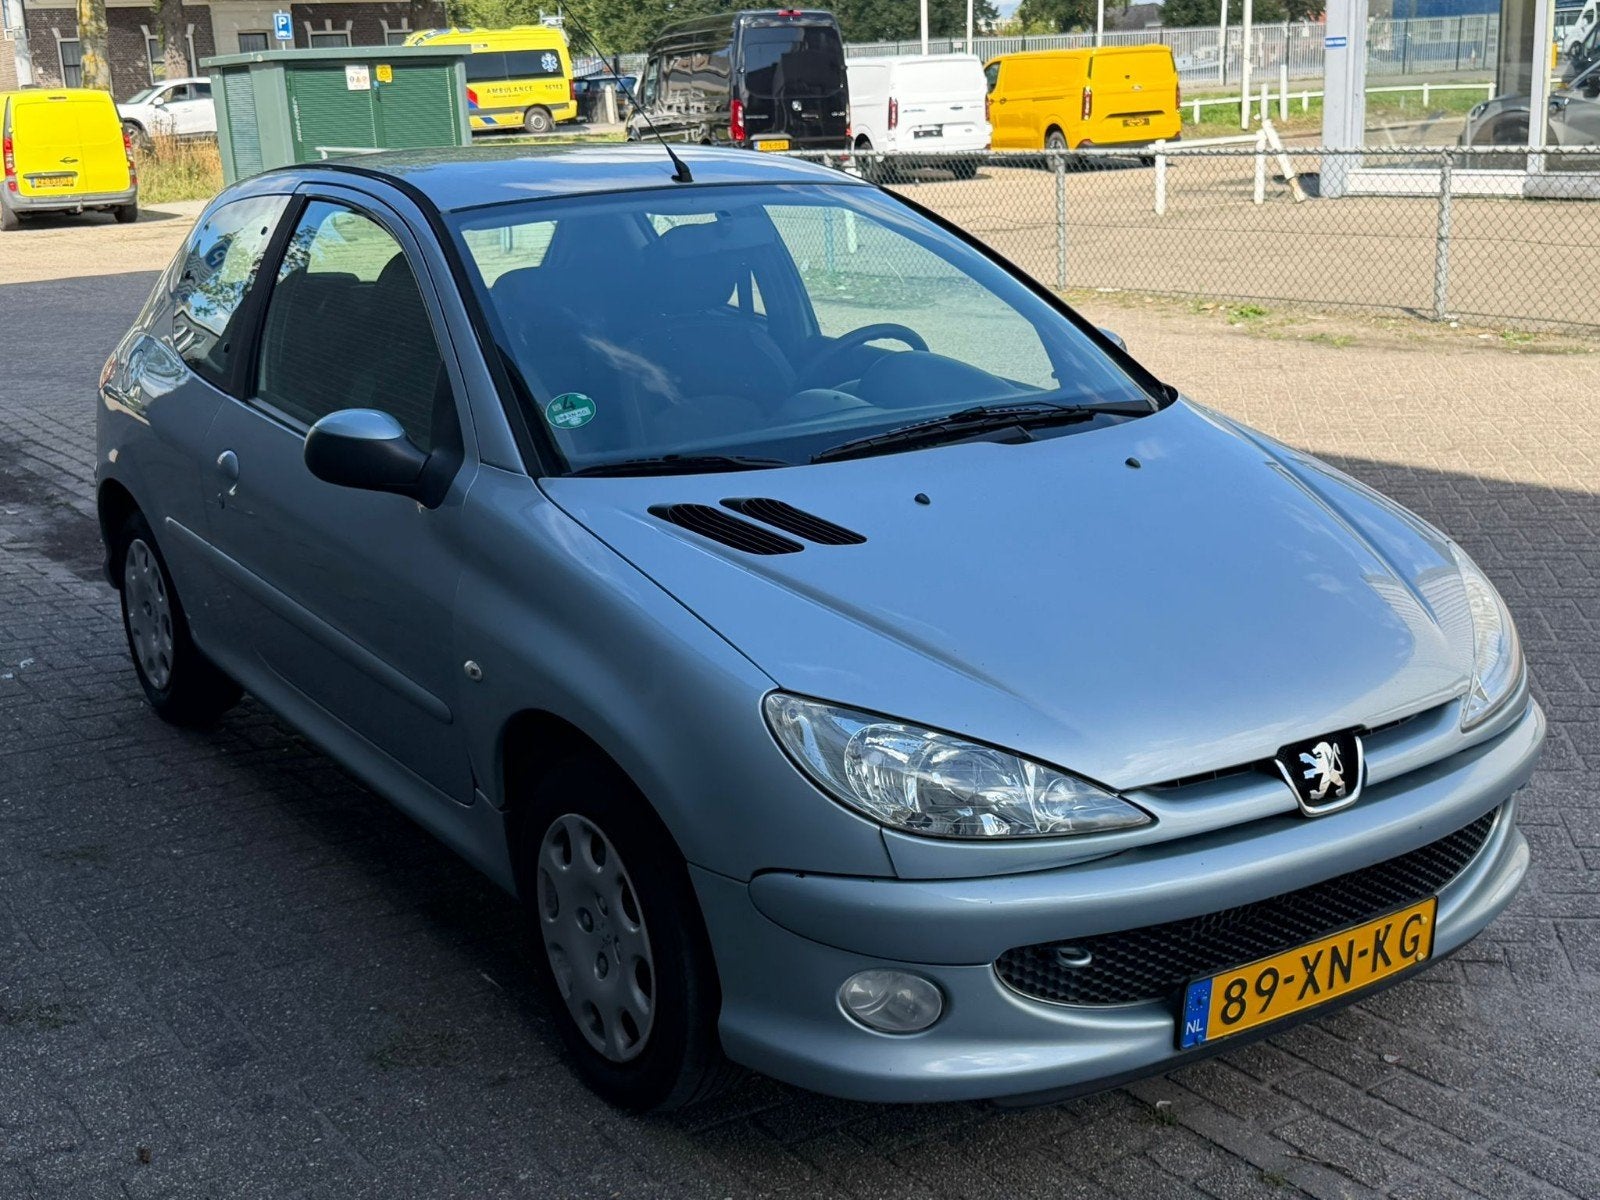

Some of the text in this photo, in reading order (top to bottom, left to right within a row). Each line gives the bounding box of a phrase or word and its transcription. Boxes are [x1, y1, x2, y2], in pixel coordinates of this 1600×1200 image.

[277, 16, 288, 29] P
[486, 85, 534, 94] AMBULANCE
[1220, 913, 1422, 1025] 89-XN-KG
[1185, 1018, 1204, 1036] NL
